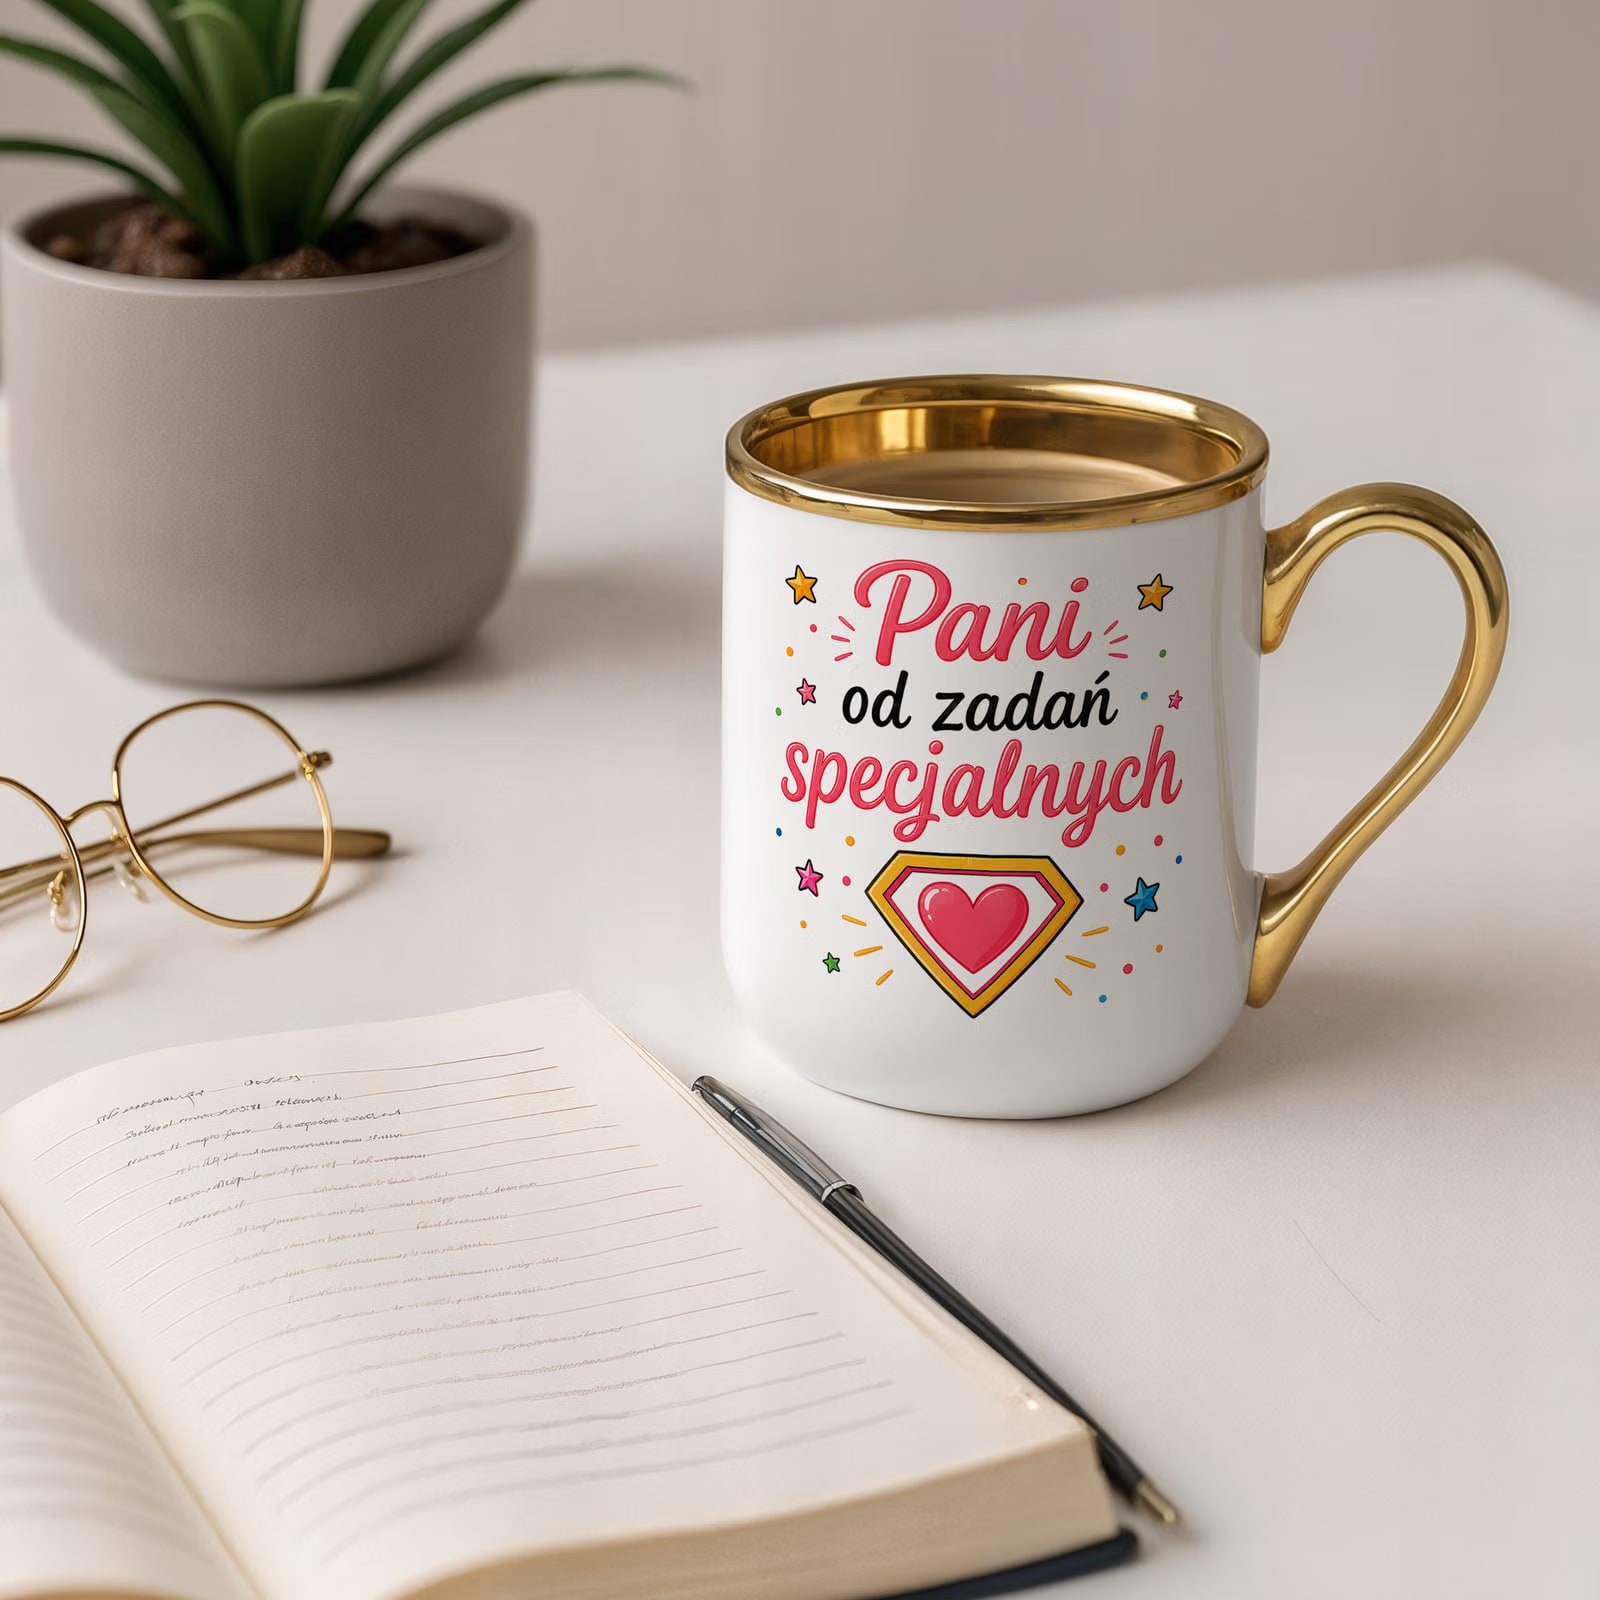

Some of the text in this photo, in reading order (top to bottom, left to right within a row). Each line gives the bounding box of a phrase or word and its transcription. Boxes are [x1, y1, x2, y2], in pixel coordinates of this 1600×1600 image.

[854, 559, 1092, 666] Pani
[842, 670, 1119, 731] od zadań
[781, 725, 1183, 848] specjalnych
